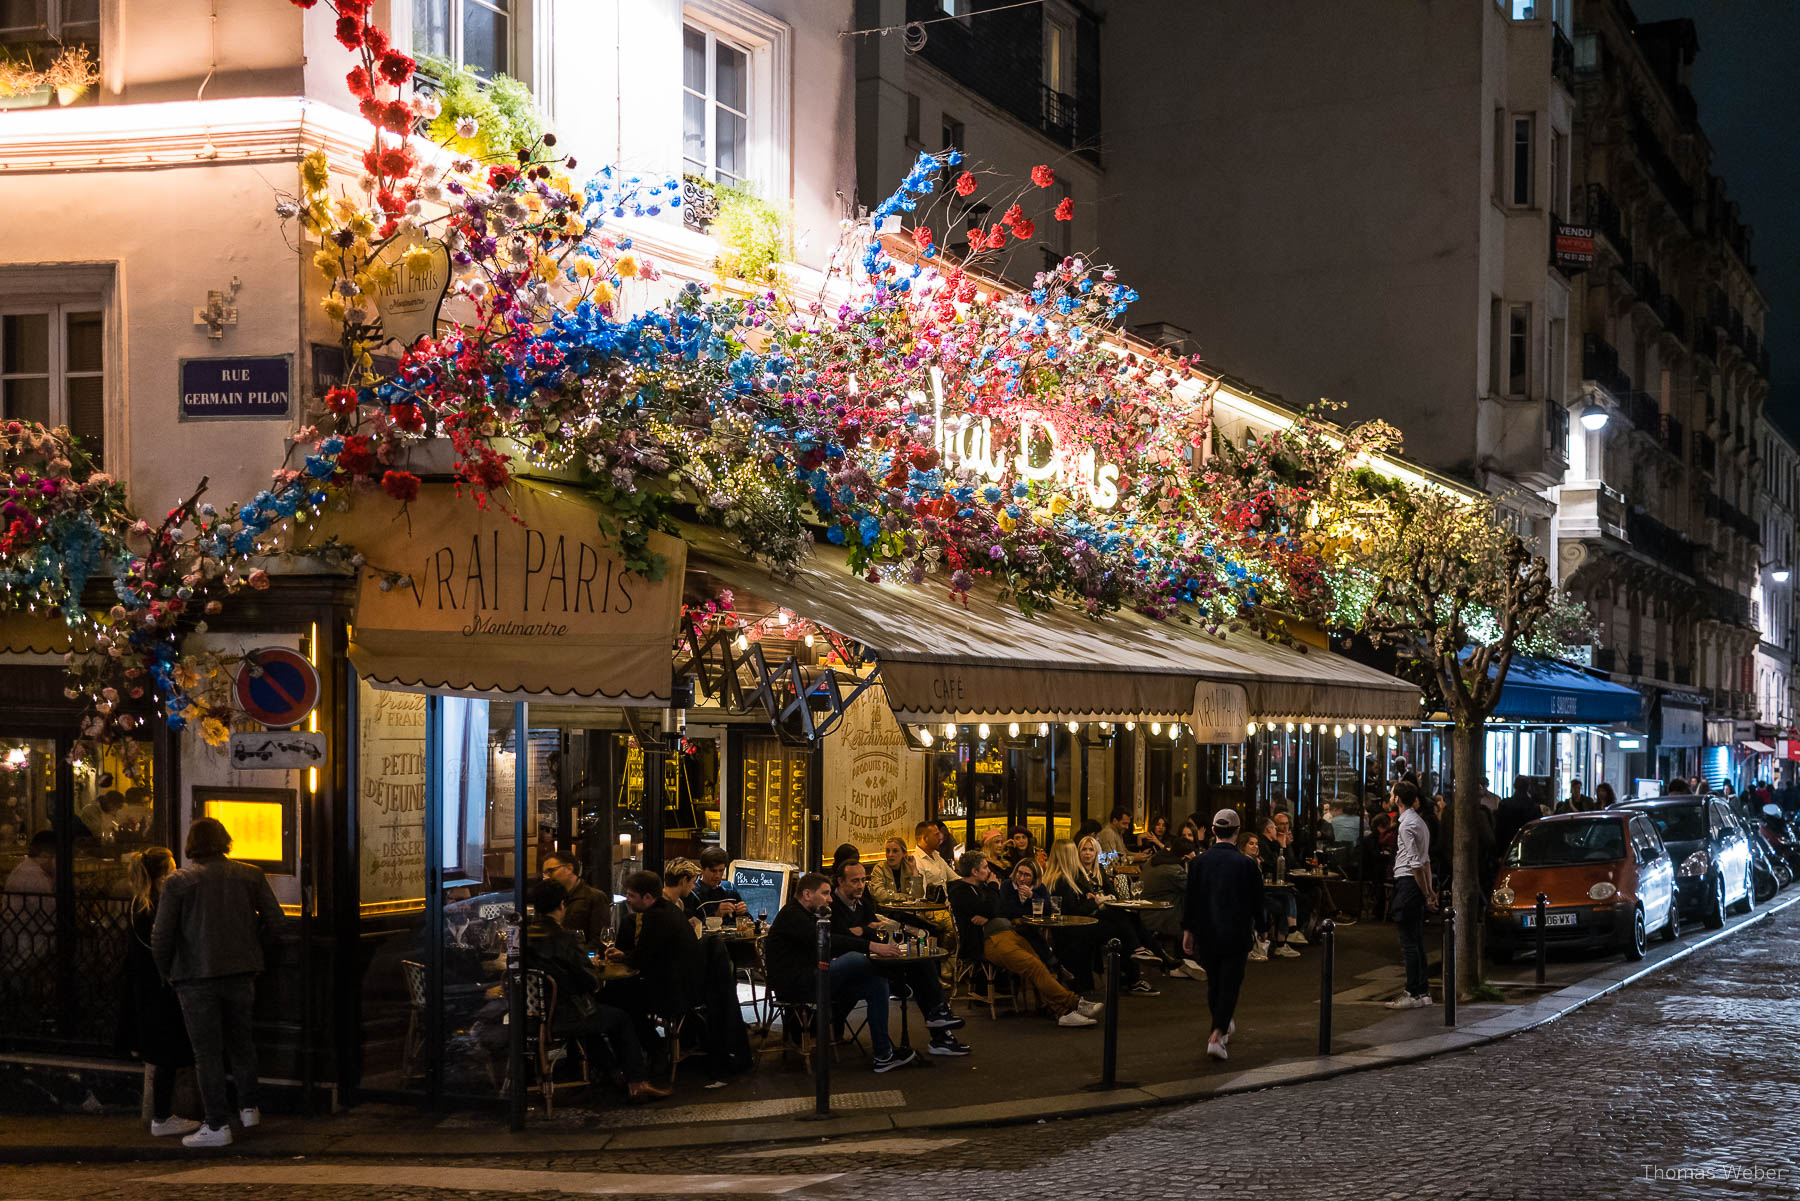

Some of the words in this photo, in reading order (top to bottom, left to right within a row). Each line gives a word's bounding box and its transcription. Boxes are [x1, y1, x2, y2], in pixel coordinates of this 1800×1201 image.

[1559, 226, 1592, 237] VENDU
[222, 369, 250, 381] RUE
[184, 392, 243, 405] GERMAIN
[248, 391, 288, 404] PILON
[408, 530, 500, 610] VRAI
[523, 529, 633, 613] PARIS
[462, 615, 569, 637] Montmartre
[934, 676, 964, 699] CAFÉ
[387, 712, 425, 727] FRAIS
[852, 760, 881, 780] PRODUITS
[882, 761, 899, 778] FRAIS
[872, 776, 878, 788] &
[852, 788, 869, 809] FAIT
[870, 786, 898, 809] MAISON
[850, 810, 878, 828] TOUTE
[880, 801, 907, 827] HEURE
